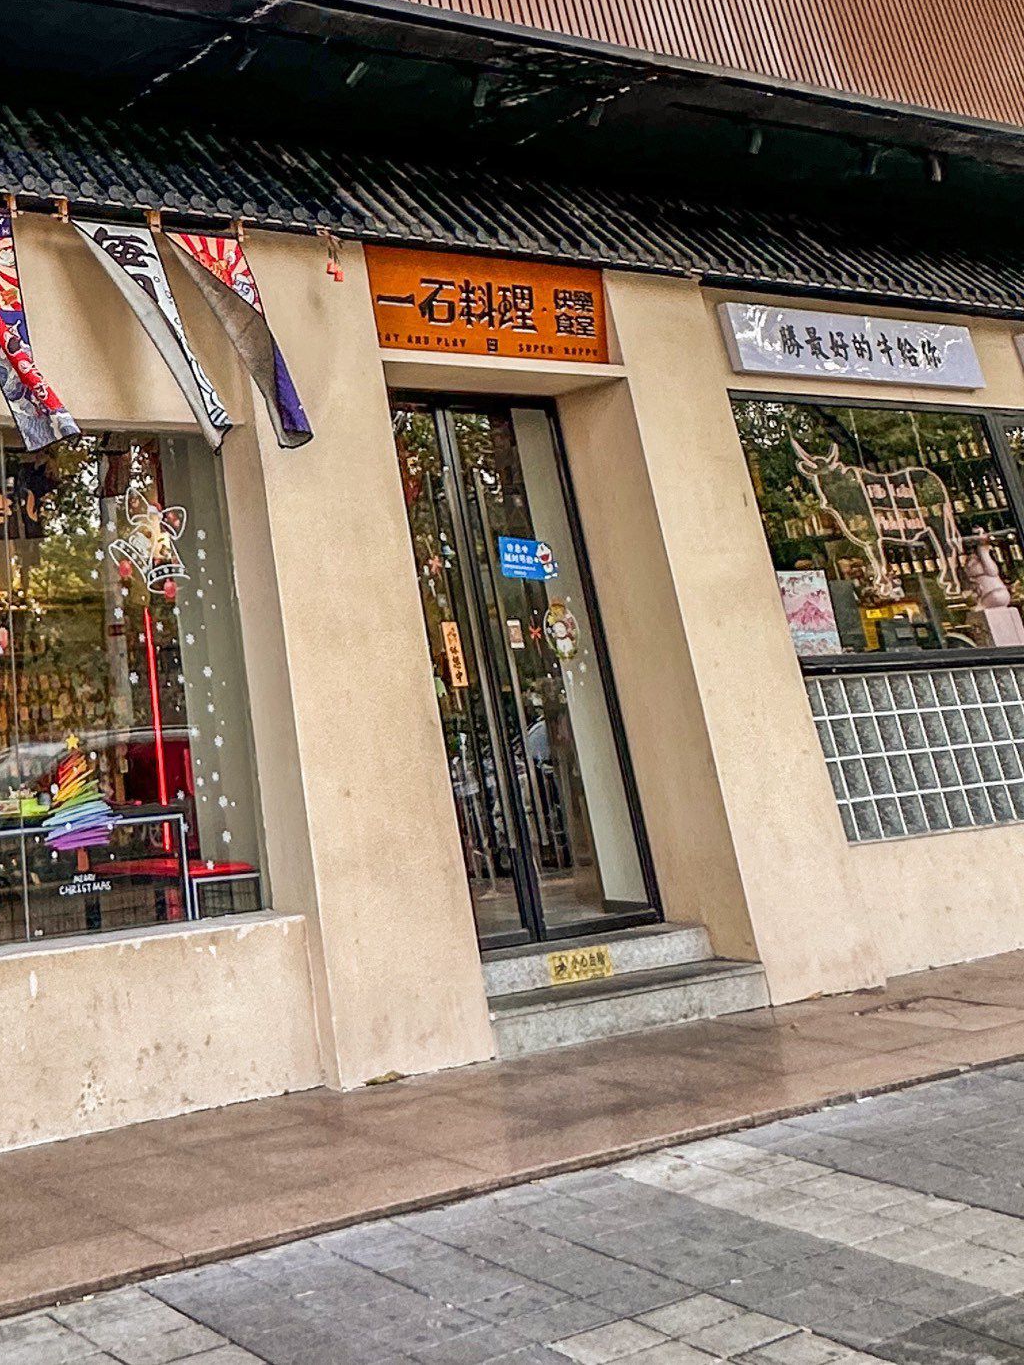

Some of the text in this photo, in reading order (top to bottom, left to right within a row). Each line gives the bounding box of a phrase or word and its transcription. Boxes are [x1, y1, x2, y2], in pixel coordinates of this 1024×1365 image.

[376, 277, 539, 334] 一石料理
[555, 312, 596, 338] 食堂
[436, 336, 467, 348] PLAY
[518, 343, 554, 354] SUPER
[59, 880, 112, 895] CHRISTMAS
